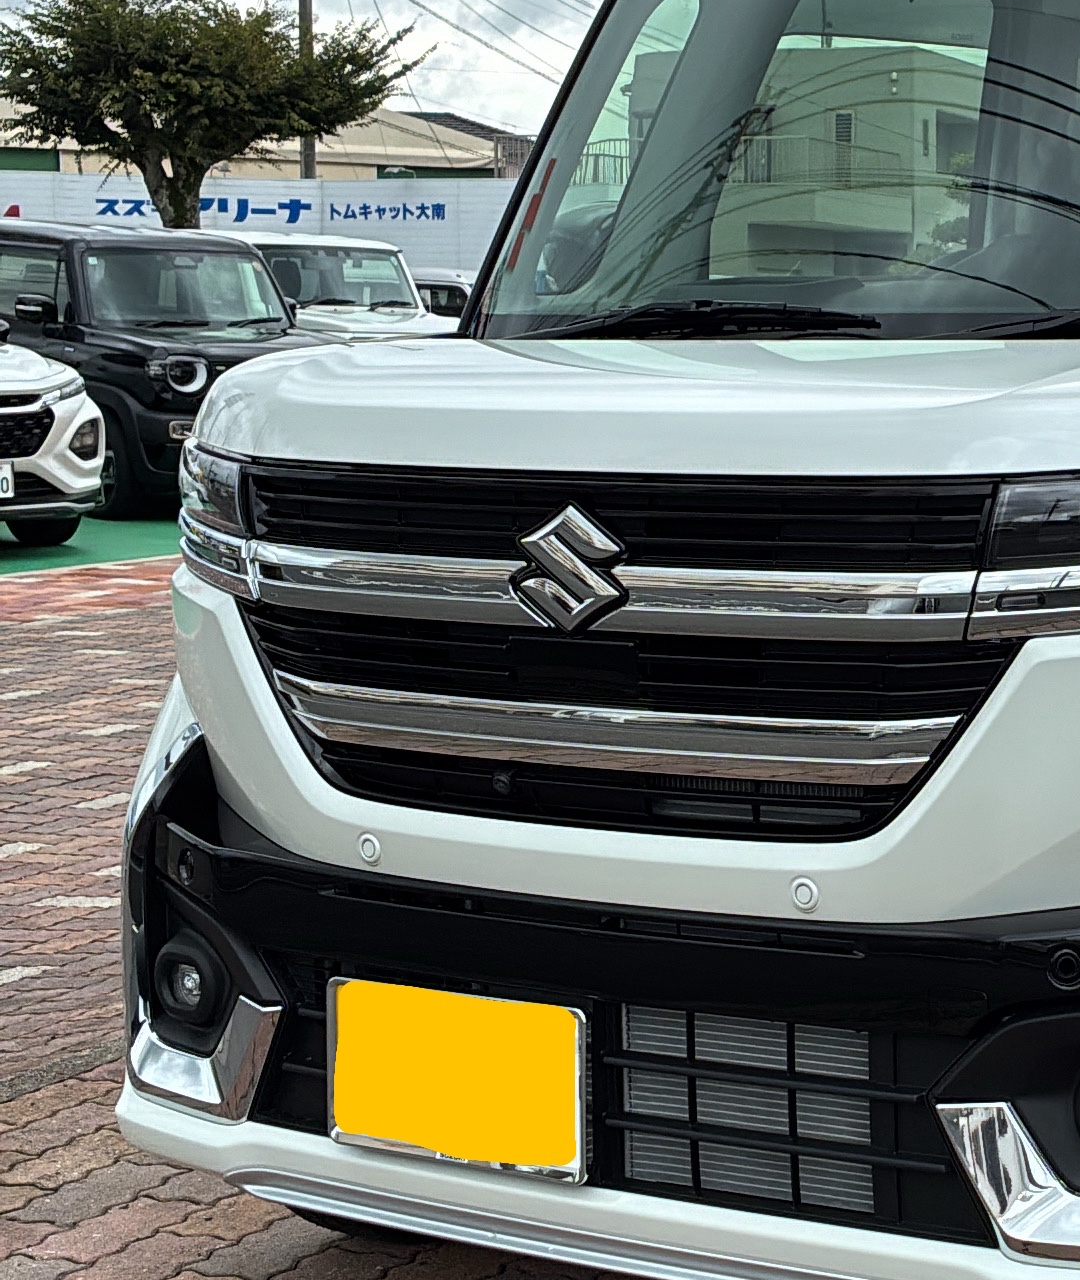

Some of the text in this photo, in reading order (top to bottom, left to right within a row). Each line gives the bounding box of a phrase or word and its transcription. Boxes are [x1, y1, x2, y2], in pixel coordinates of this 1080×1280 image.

[329, 203, 446, 221] トムキャット大南
